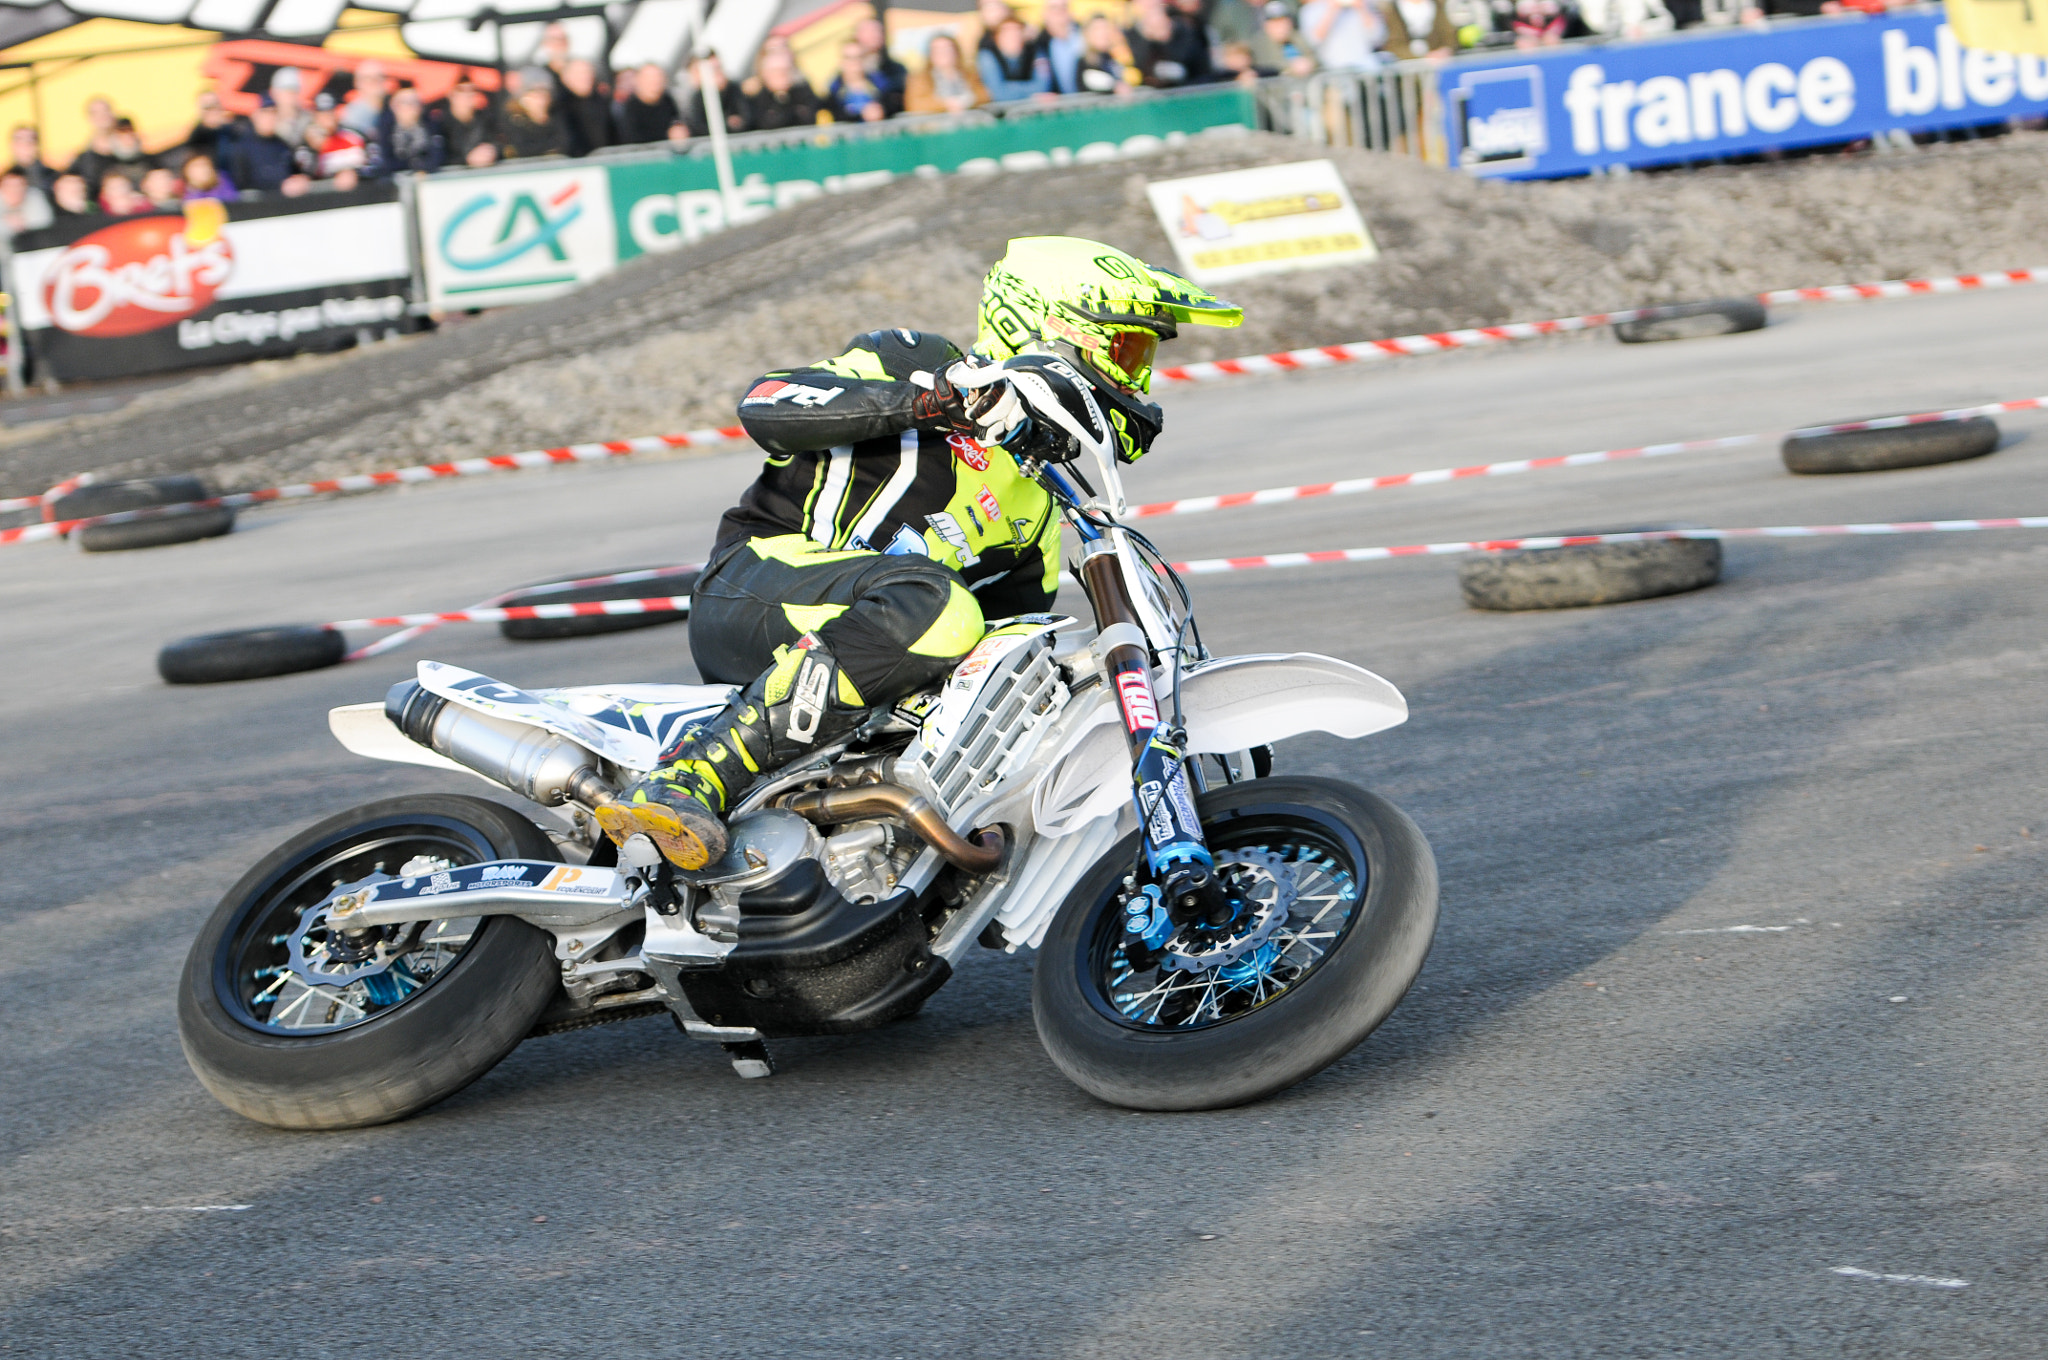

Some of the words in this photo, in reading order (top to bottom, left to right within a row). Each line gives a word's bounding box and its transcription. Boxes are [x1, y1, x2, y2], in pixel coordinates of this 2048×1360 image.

[1564, 56, 1856, 156] france
[1045, 314, 1101, 351] EKS
[467, 879, 534, 890] MOTORSPORTS
[481, 865, 529, 881] RAW
